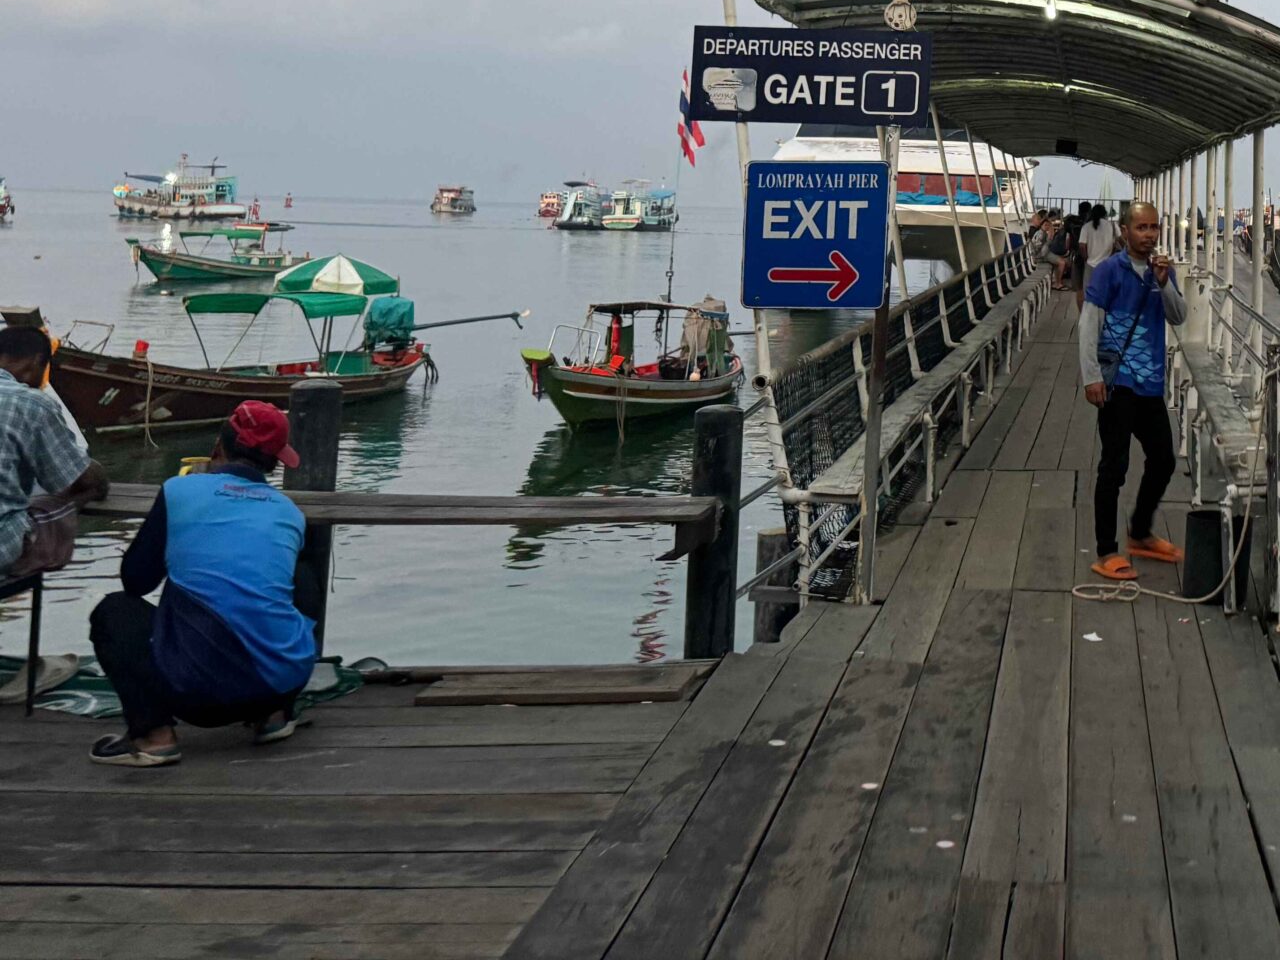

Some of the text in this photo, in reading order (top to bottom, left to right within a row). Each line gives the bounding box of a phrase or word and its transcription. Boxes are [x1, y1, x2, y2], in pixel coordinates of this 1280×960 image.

[703, 38, 923, 61] DEPARTURES PASSENGER
[763, 74, 857, 107] GATE
[881, 78, 896, 108] 1
[758, 172, 879, 190] LOMPRAYAH PIER
[762, 200, 869, 240] EXIT
